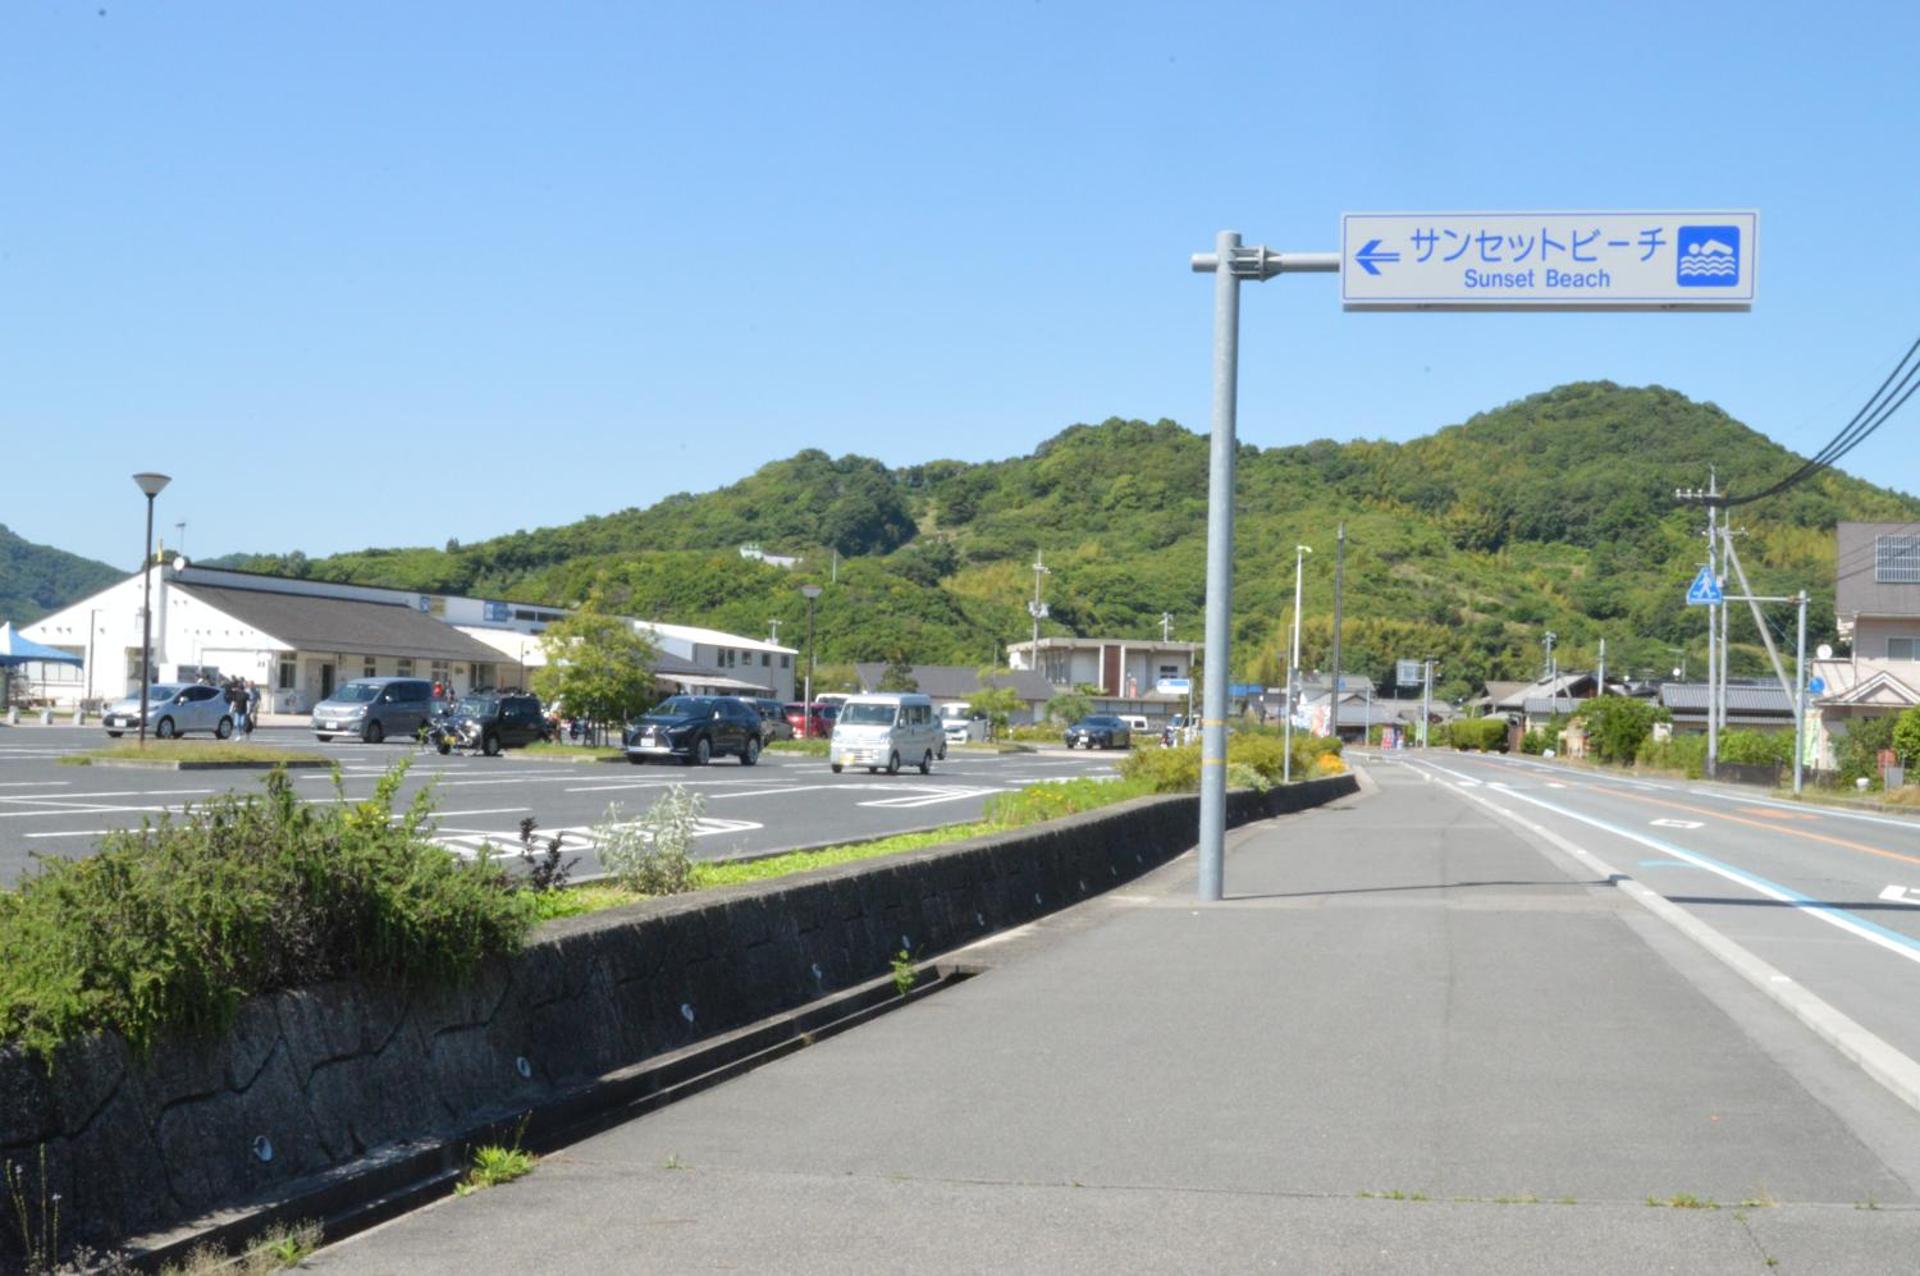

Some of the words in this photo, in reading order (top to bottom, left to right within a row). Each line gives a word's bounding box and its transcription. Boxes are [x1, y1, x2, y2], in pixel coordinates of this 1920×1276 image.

[1411, 227, 1666, 263] サンセットビーチ
[1464, 268, 1535, 288] Sunset
[1546, 268, 1611, 288] Beach
